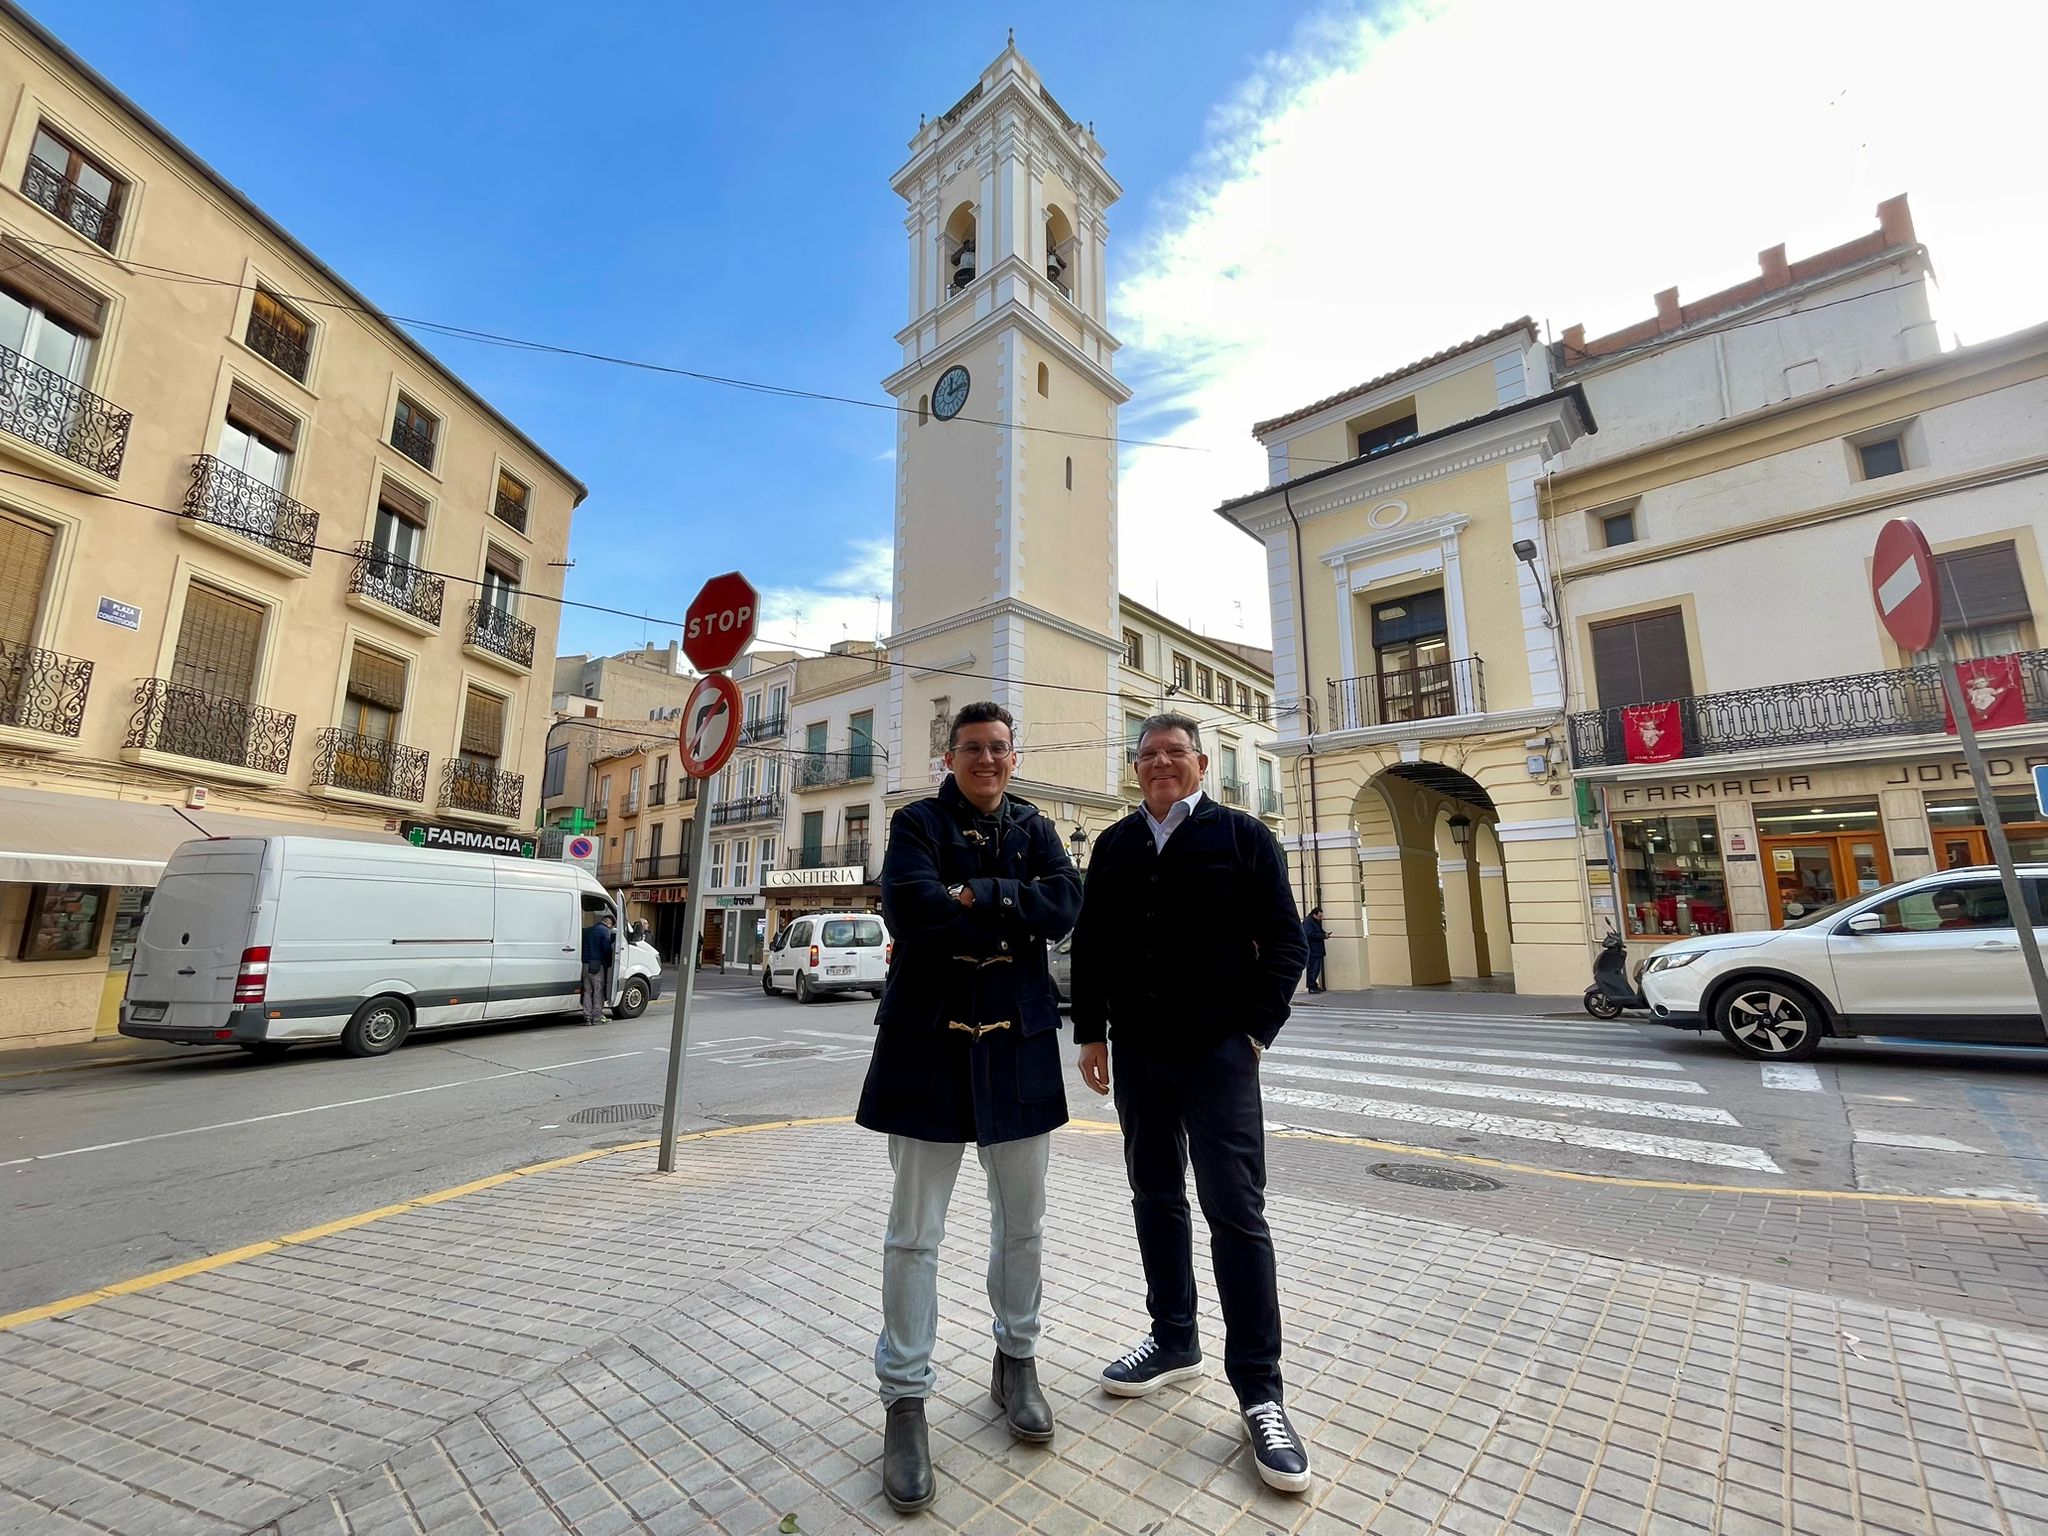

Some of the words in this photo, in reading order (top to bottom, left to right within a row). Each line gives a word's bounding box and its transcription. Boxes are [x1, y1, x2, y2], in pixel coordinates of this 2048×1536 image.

[112, 603, 135, 615] PLAZA
[687, 605, 752, 640] STOP
[1624, 775, 1811, 804] FARMACIA
[426, 827, 521, 853] FARMACIA
[772, 869, 855, 885] CONFITERIA
